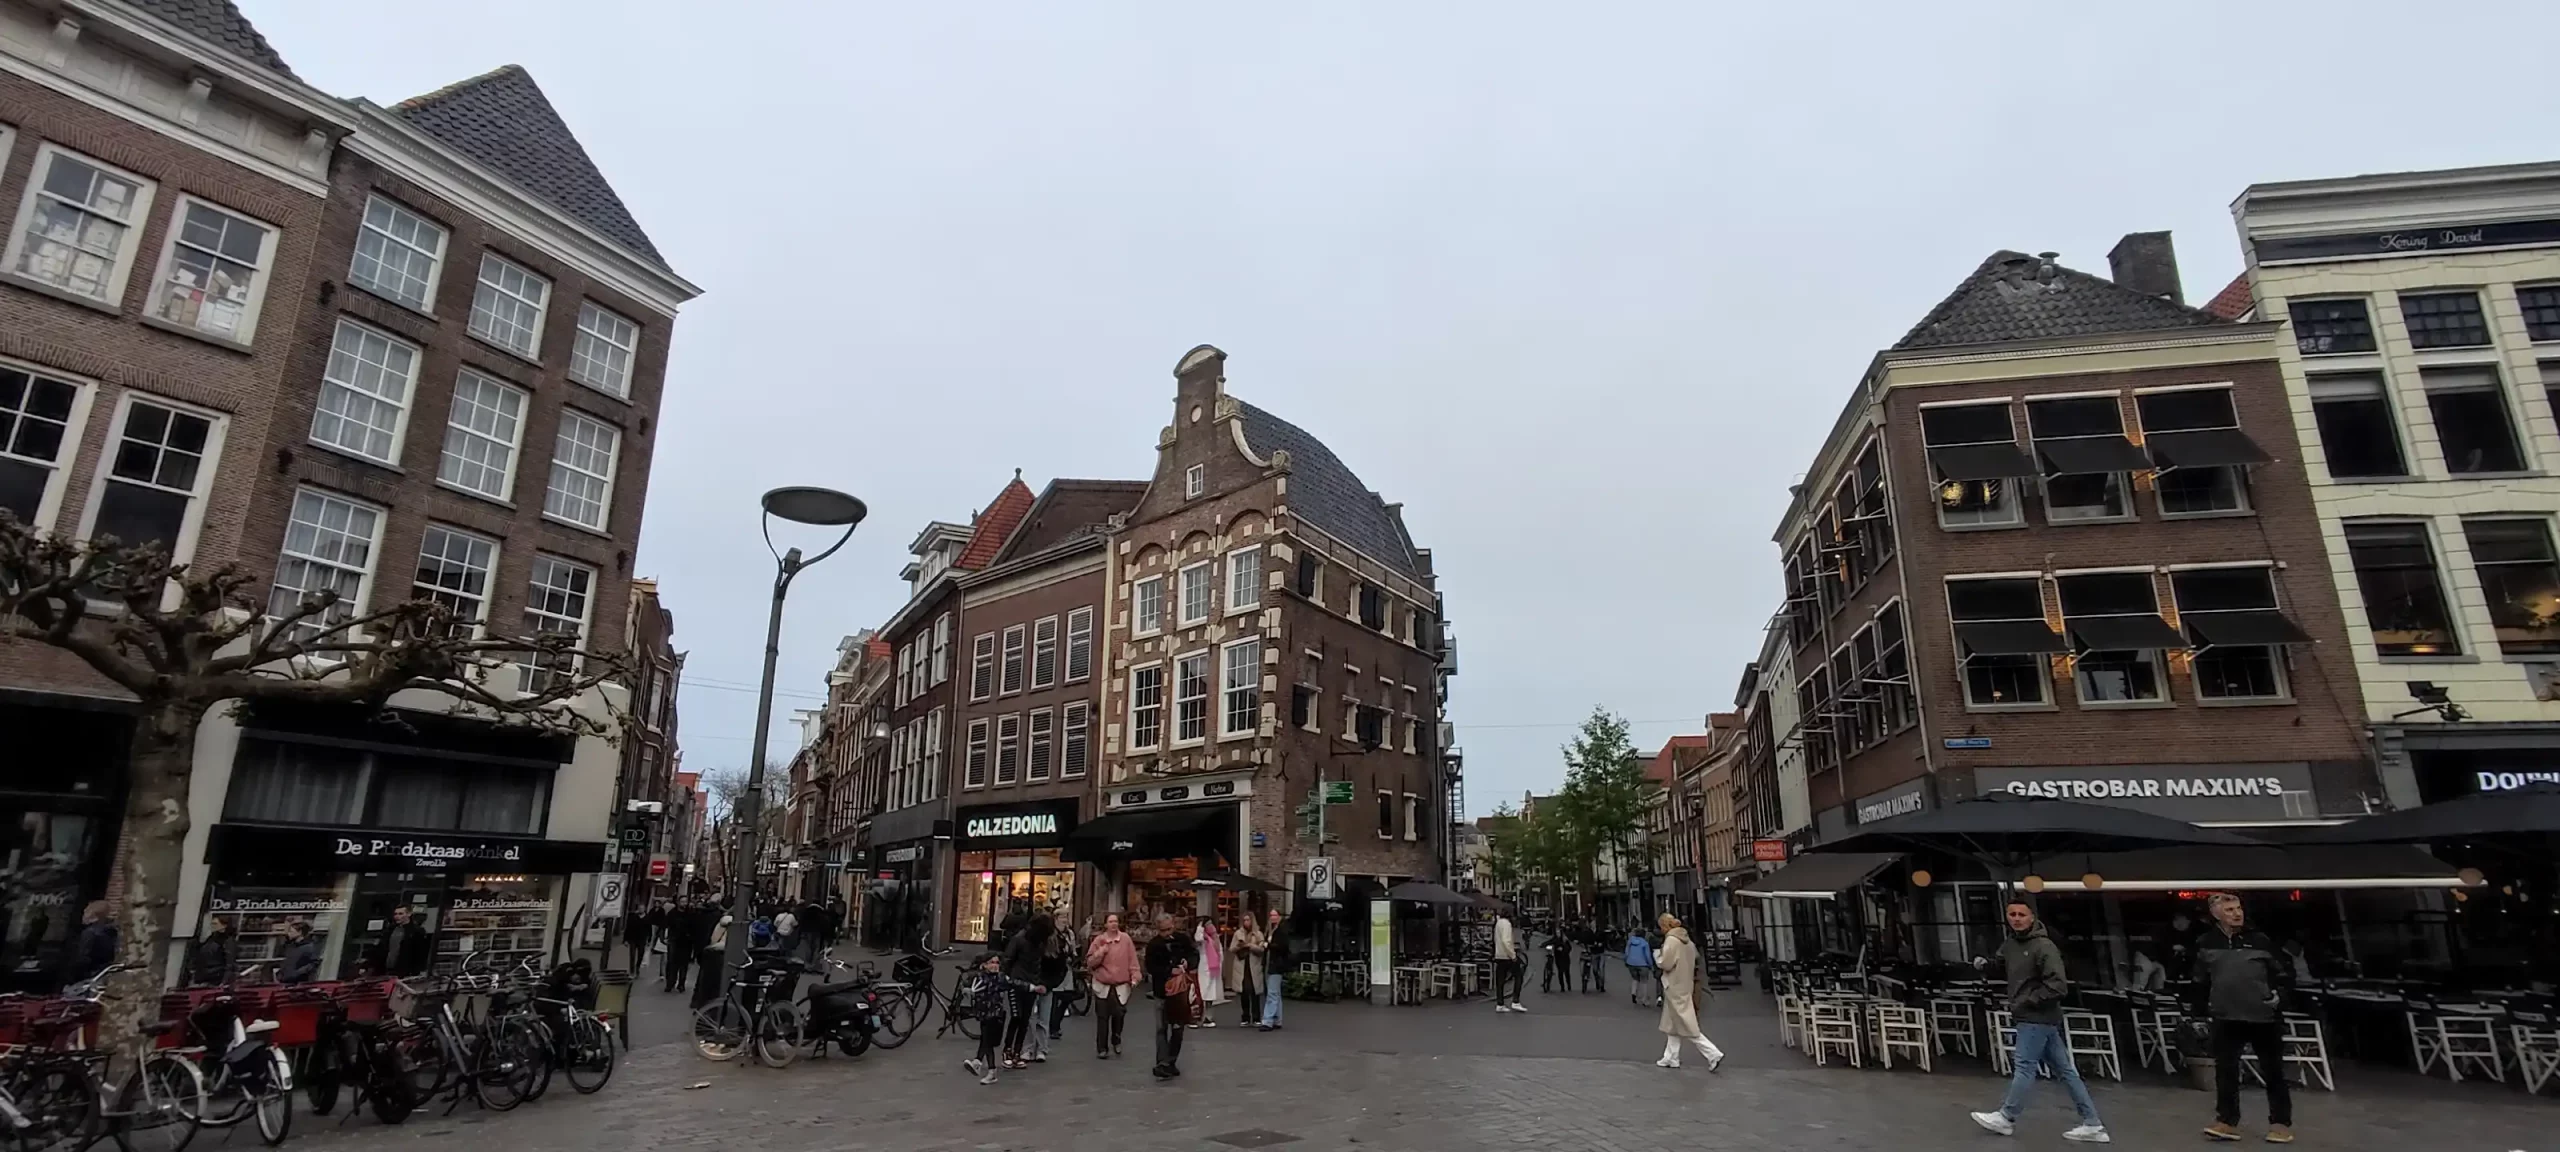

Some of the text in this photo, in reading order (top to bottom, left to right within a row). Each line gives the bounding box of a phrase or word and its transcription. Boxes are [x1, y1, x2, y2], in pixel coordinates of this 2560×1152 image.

[2439, 229, 2482, 244] David
[2007, 780, 2160, 798] GASTROBAR
[1858, 802, 1892, 824] GASTROBAR
[967, 814, 1056, 837] CALZEDONIA
[335, 838, 520, 860] De Pindakaaswinkel
[416, 858, 446, 867] Zwolle
[212, 899, 348, 910] De Pindakaaswinkel
[453, 899, 553, 908] De Pindakaaswinkel
